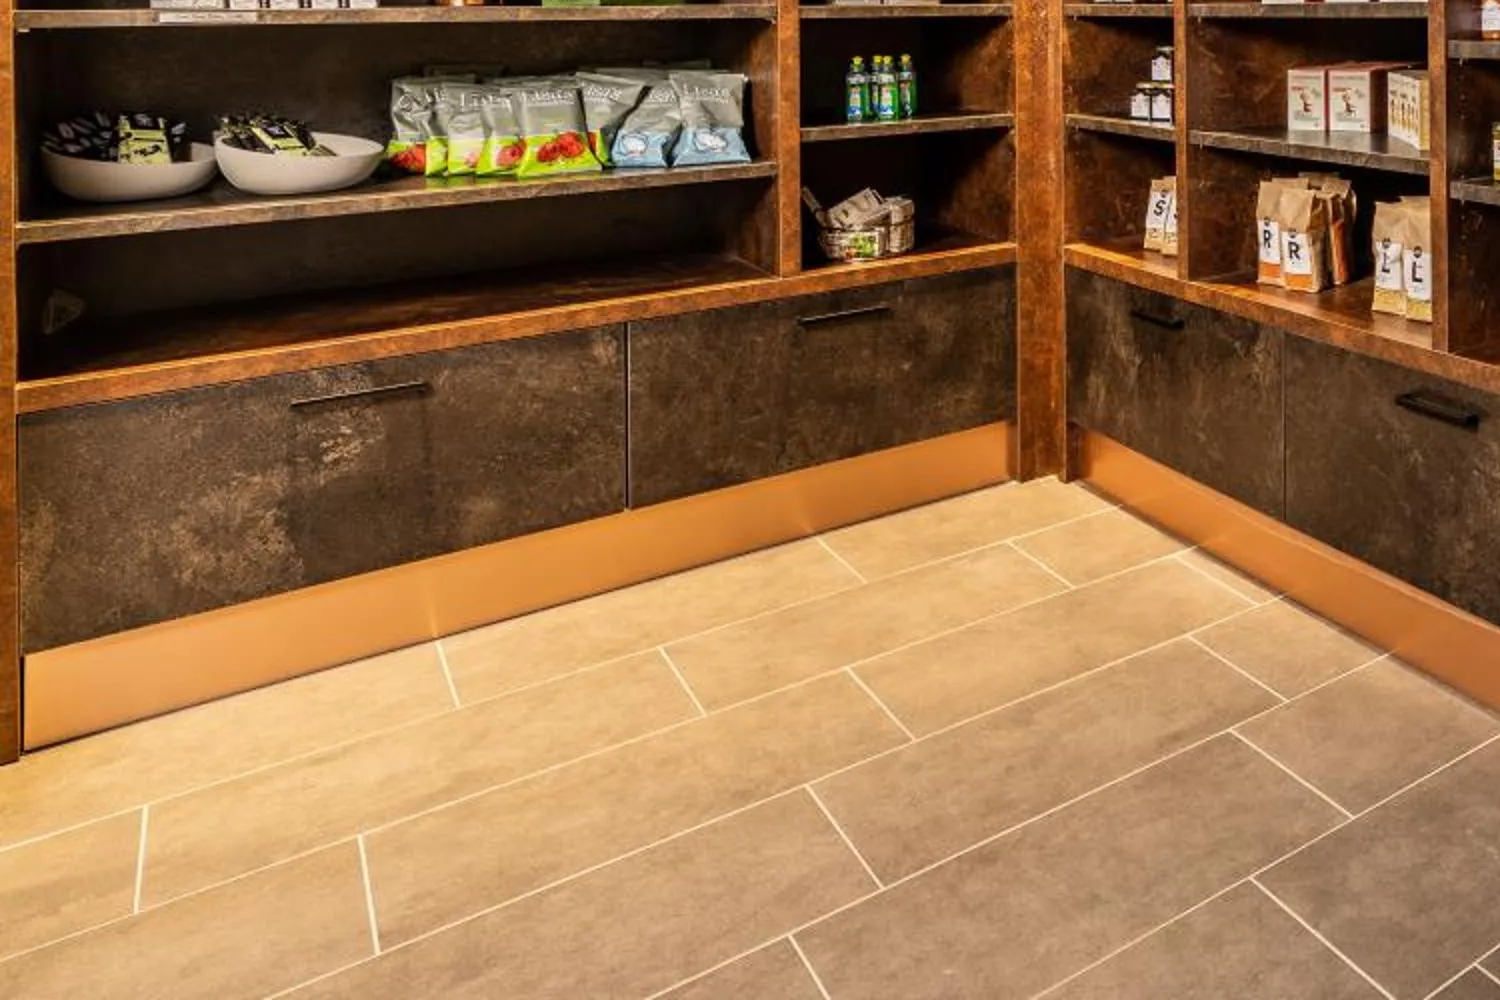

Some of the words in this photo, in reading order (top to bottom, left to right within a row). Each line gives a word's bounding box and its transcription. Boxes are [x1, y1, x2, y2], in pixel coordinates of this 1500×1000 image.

[1153, 200, 1167, 215] S
[1288, 241, 1300, 261] R
[1412, 261, 1423, 283] L
